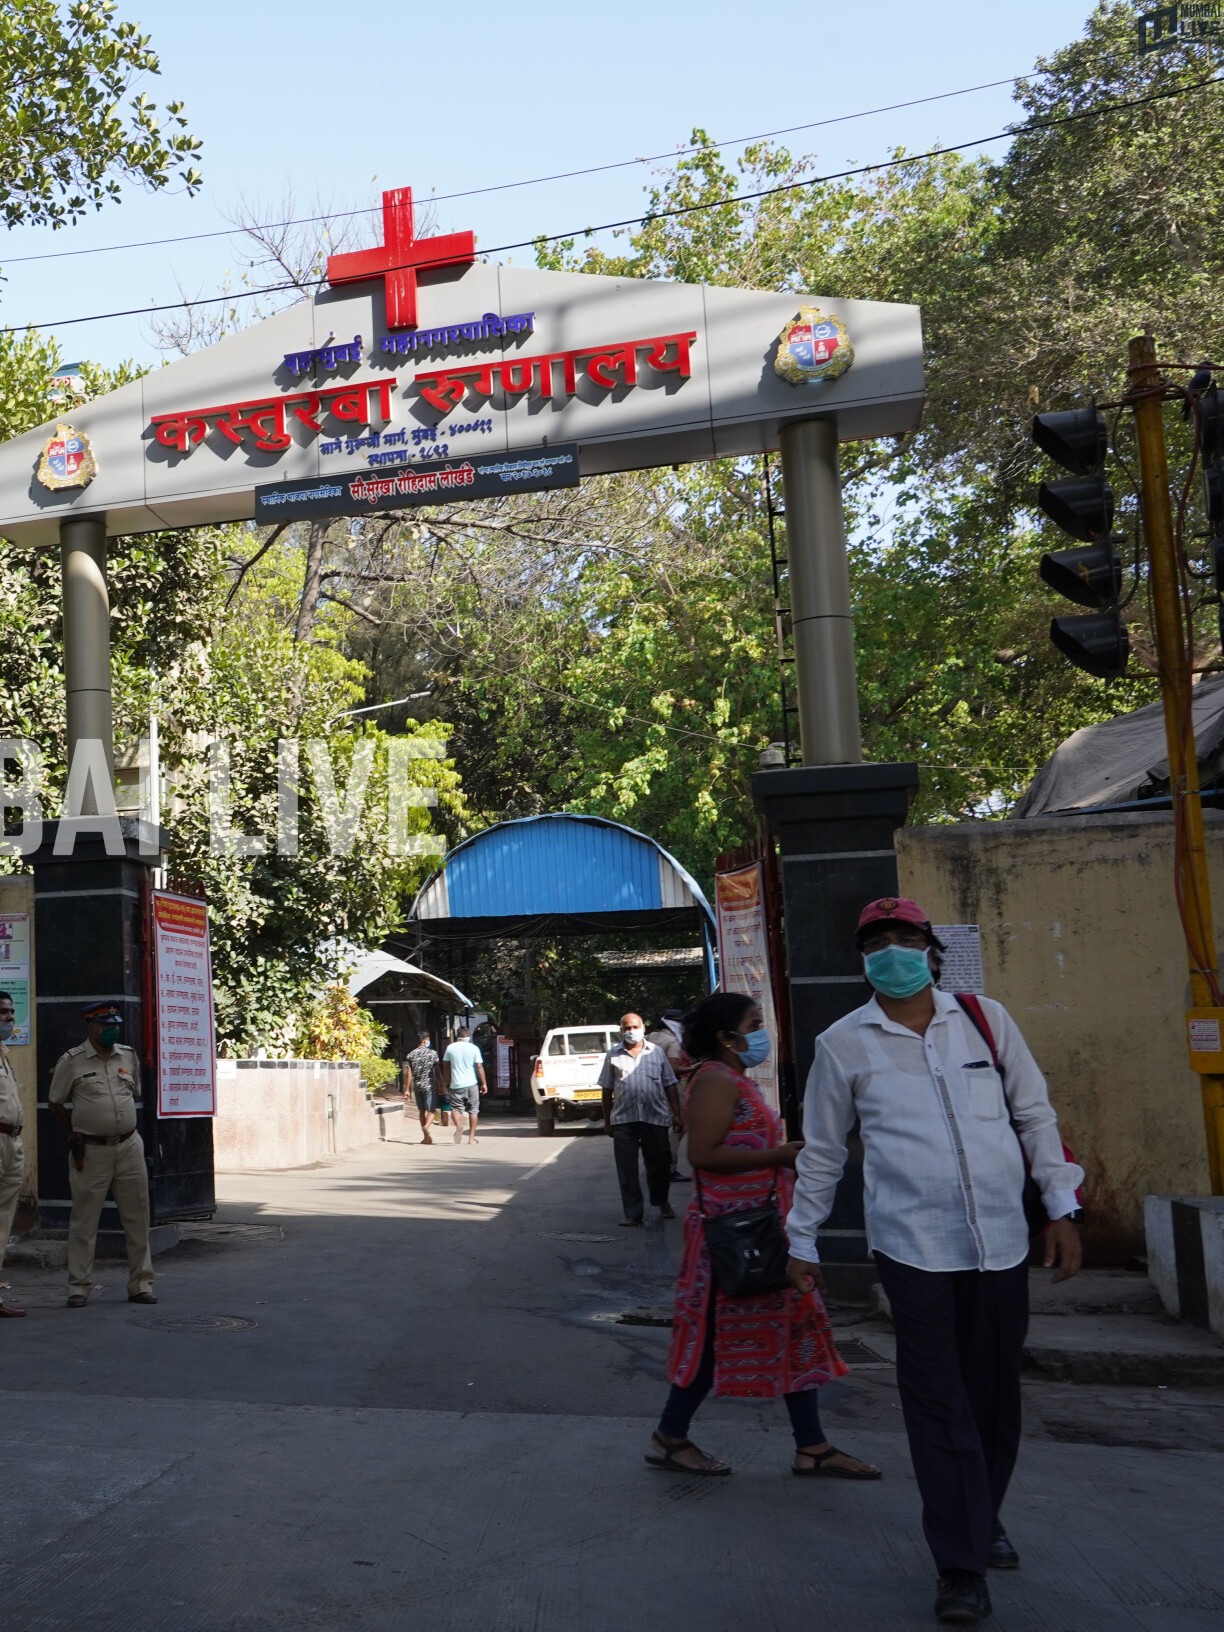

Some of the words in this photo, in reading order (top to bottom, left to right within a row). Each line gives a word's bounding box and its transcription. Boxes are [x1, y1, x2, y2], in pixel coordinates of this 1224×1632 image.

[379, 312, 536, 355] महानगरपालिका
[151, 378, 399, 452] कस्तुरबा
[415, 330, 697, 413] रुग्णालय
[319, 436, 343, 455] साने
[410, 422, 438, 446] मुंबई
[366, 448, 409, 468] स्थापना
[397, 467, 438, 493] रोहिदास
[438, 462, 476, 488] लोखंडे
